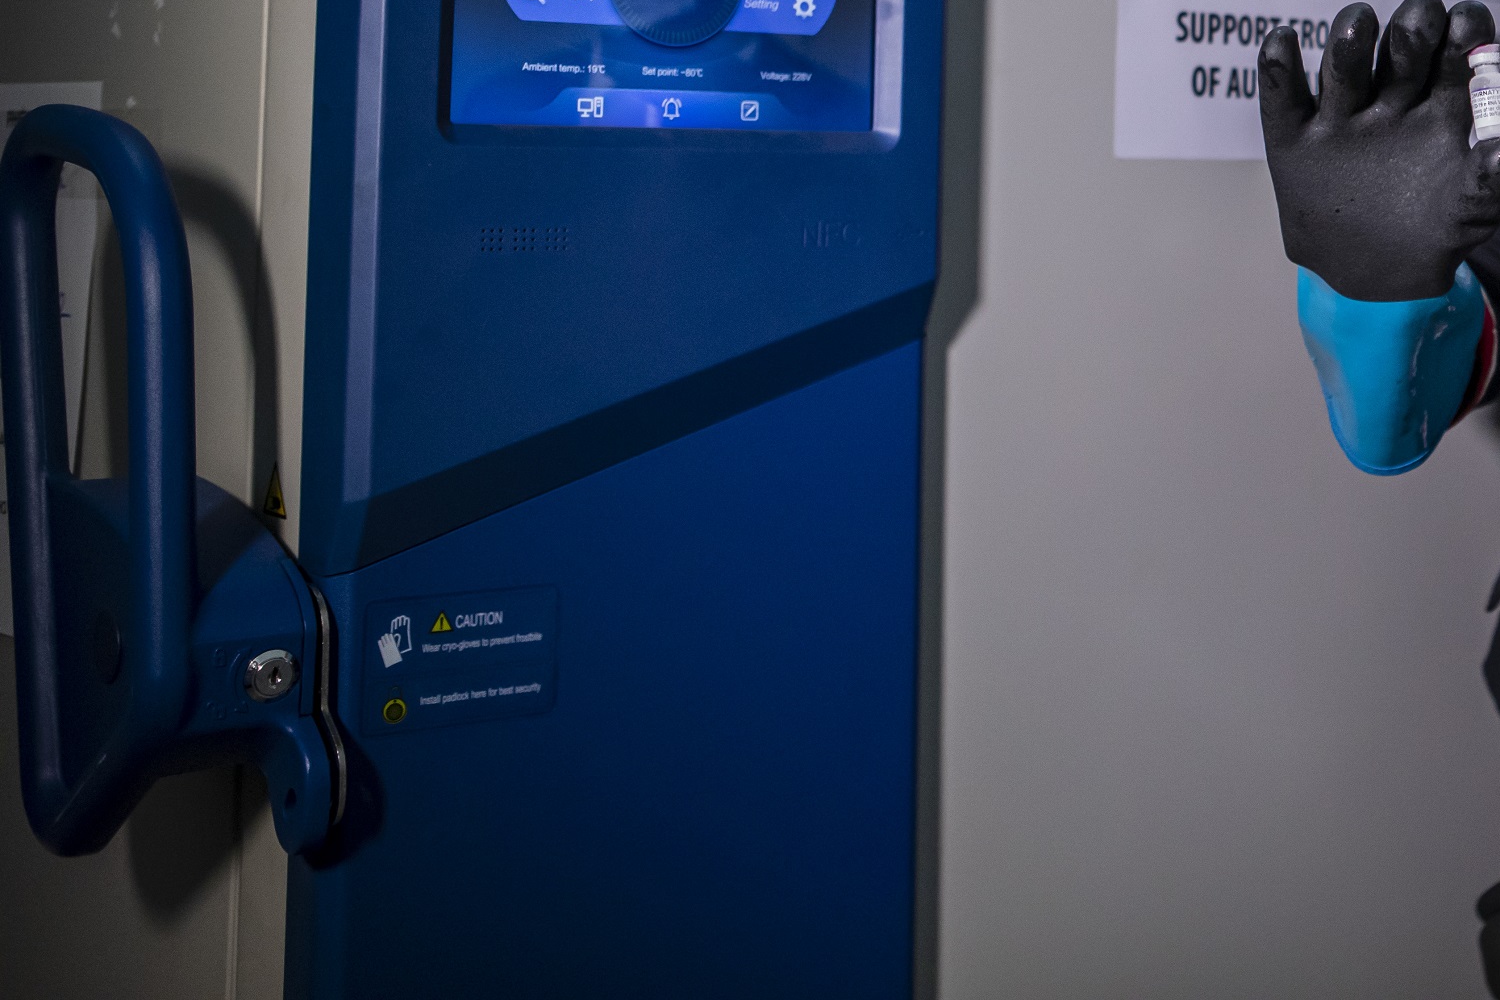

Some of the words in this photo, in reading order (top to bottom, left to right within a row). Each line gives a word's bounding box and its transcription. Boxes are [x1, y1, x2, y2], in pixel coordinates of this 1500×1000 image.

[522, 62, 558, 72] Ambient
[642, 66, 656, 76] Set
[1193, 66, 1220, 98] OF
[455, 611, 504, 628] CAUTION
[422, 644, 441, 653] Wear
[490, 635, 516, 647] prevent
[420, 694, 441, 706] Install
[442, 692, 469, 704] padlock
[470, 690, 487, 699] here
[488, 688, 498, 696] for
[515, 682, 541, 694] security
